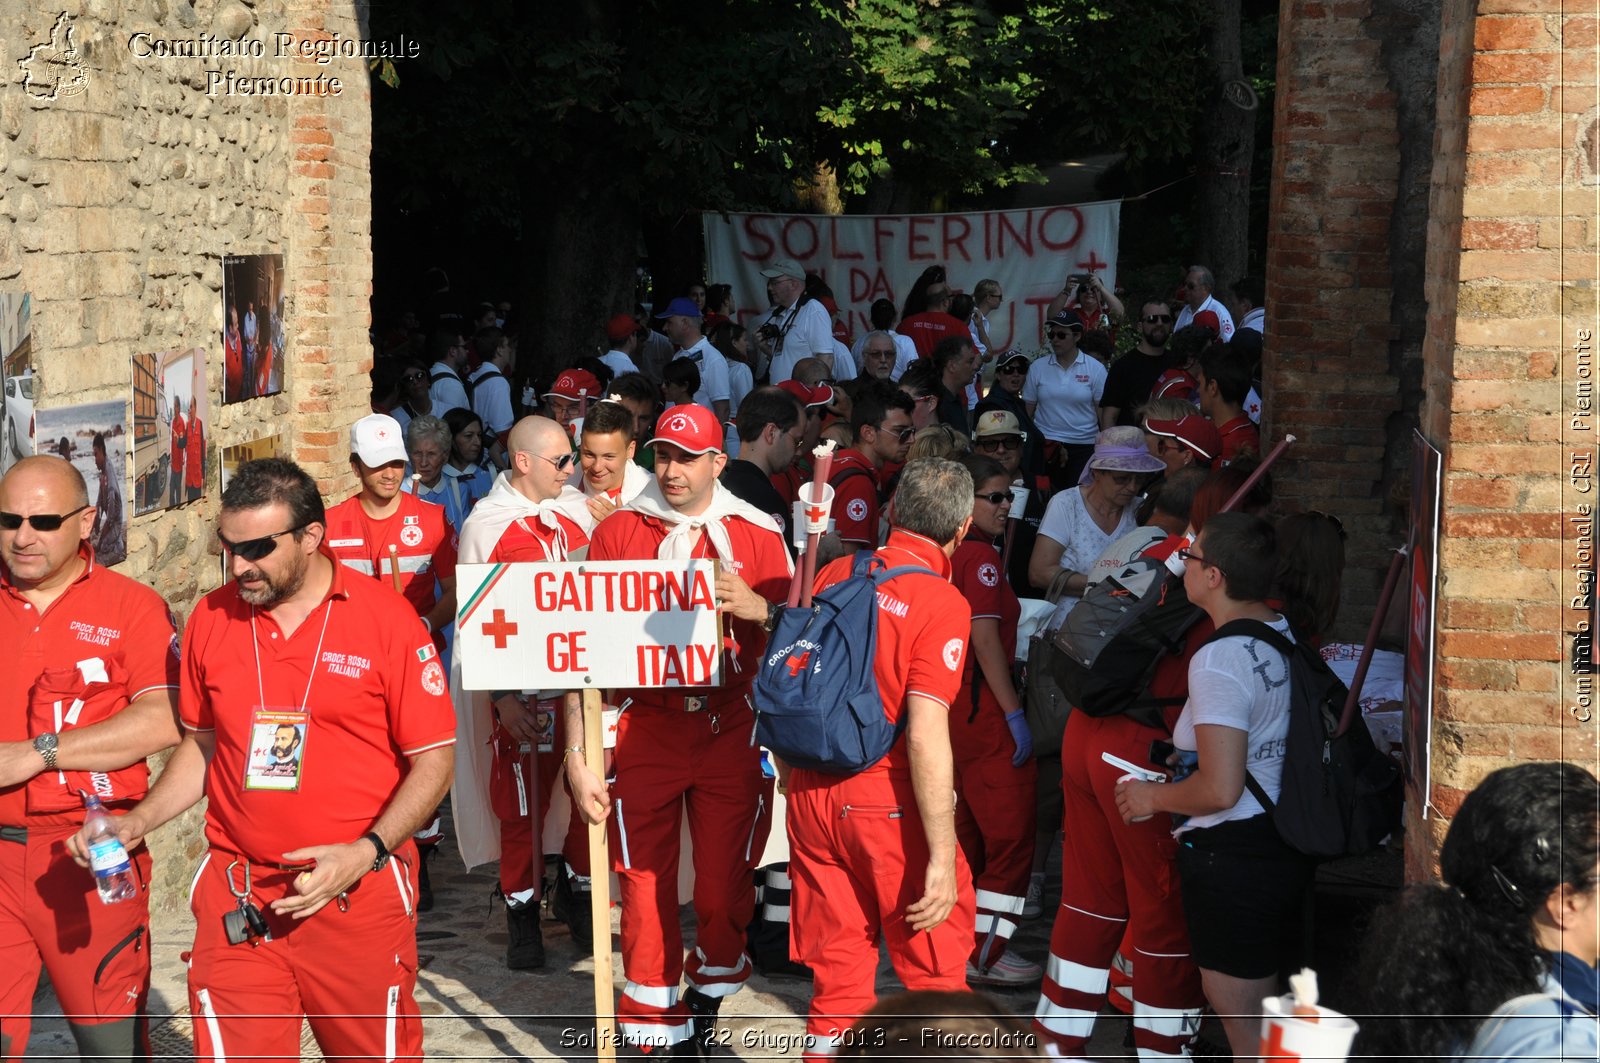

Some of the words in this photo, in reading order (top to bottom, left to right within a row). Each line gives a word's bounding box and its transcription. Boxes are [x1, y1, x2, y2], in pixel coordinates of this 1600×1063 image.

[741, 206, 1084, 262] SOLFERINO
[850, 267, 895, 303] DA
[534, 570, 715, 612] GATTORNA
[70, 621, 95, 633] CROCE
[76, 631, 110, 647] ITALIANA
[321, 651, 346, 664] CROCE
[347, 655, 371, 671] ROSSA
[327, 663, 361, 679] ITALIANA
[546, 631, 589, 673] GE
[636, 644, 716, 686] ITALY
